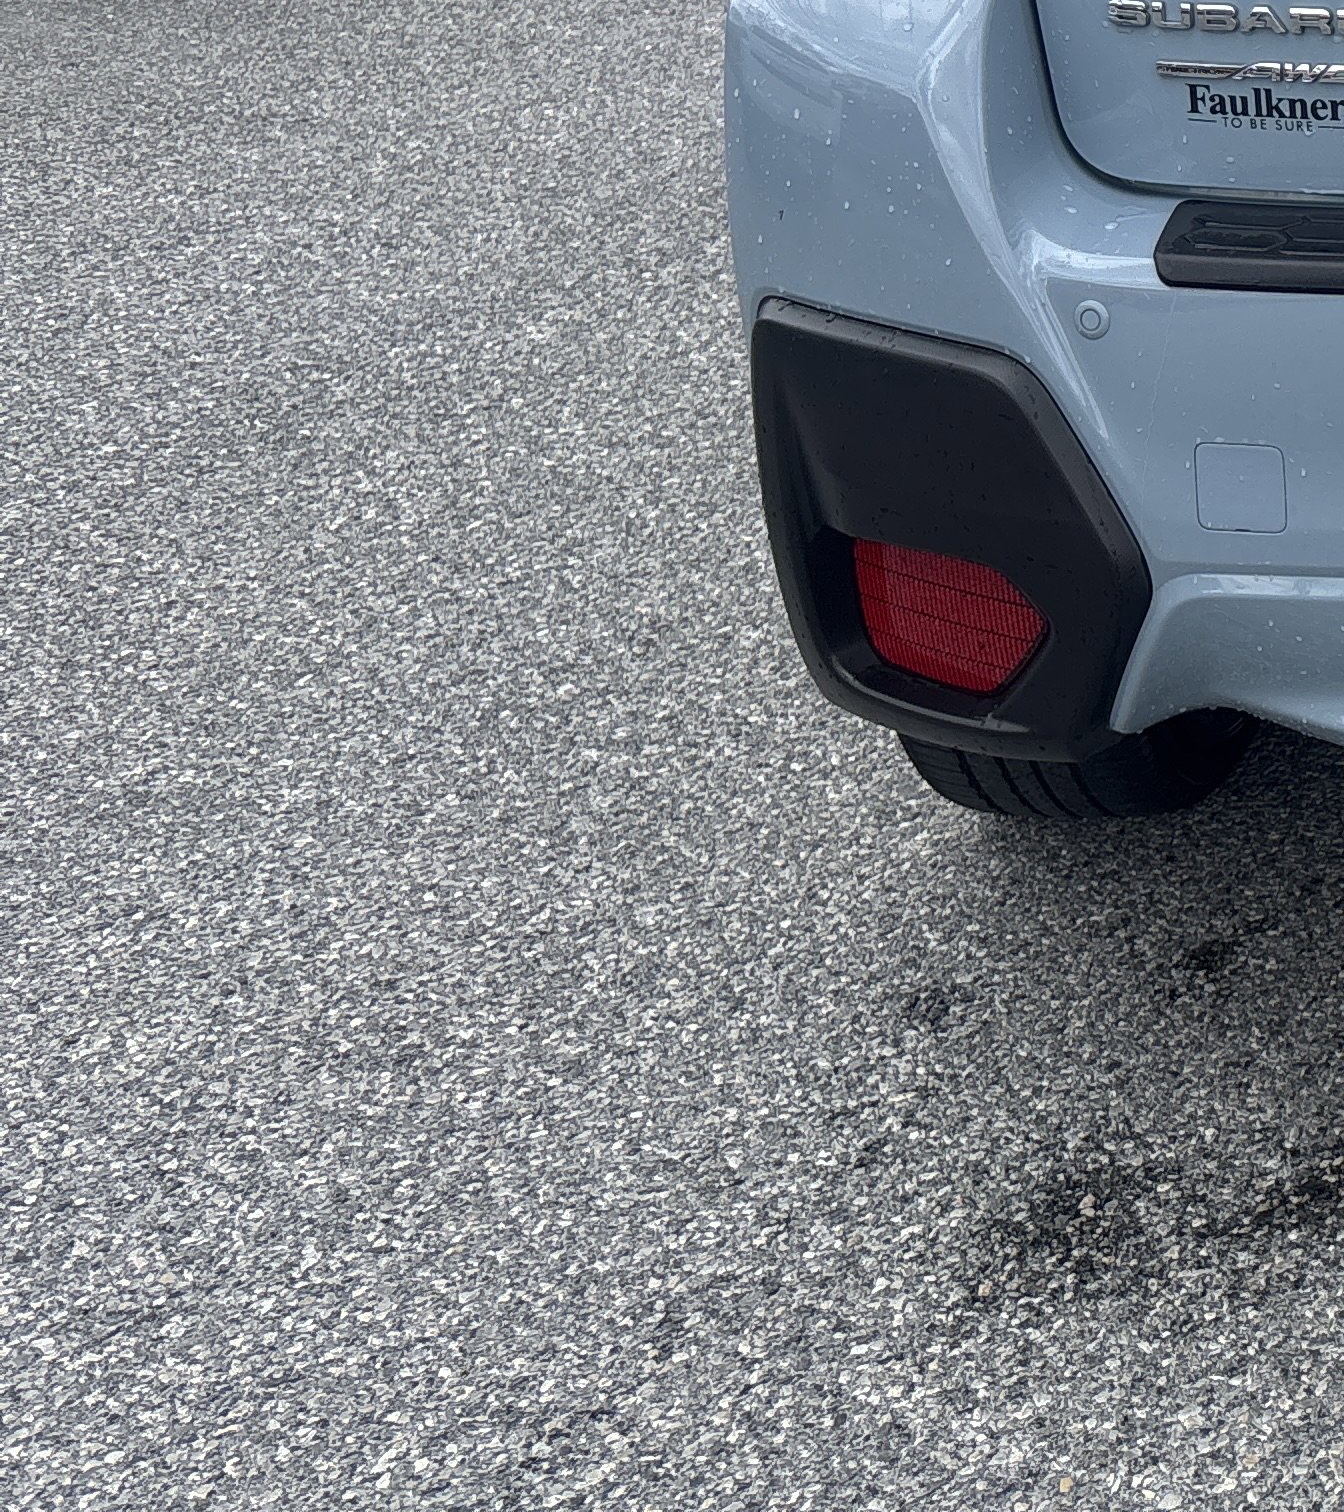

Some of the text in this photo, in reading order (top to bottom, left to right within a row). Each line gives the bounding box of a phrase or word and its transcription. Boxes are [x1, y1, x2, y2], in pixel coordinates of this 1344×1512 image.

[1221, 116, 1315, 132] TO BE SURE
